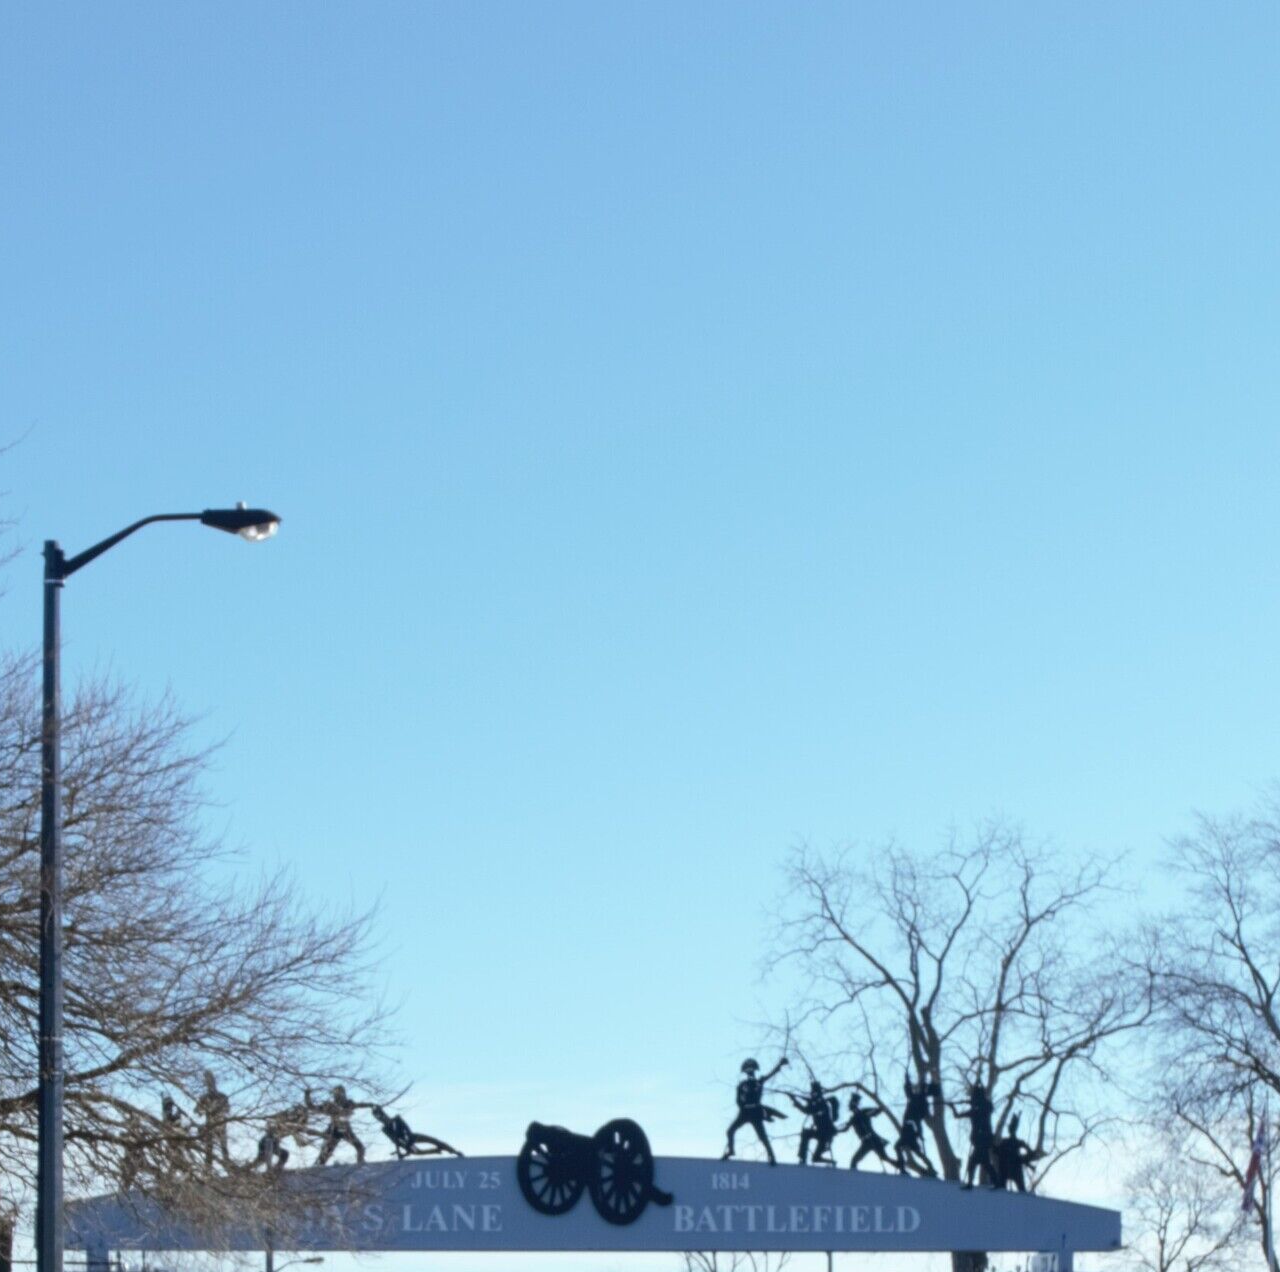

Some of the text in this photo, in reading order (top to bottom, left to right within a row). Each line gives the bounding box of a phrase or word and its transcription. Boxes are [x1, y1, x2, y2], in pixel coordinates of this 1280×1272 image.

[410, 1170, 750, 1190] JULY 25 1814
[402, 1204, 503, 1232] LANE
[673, 1204, 921, 1233] BATTLEFIELD
